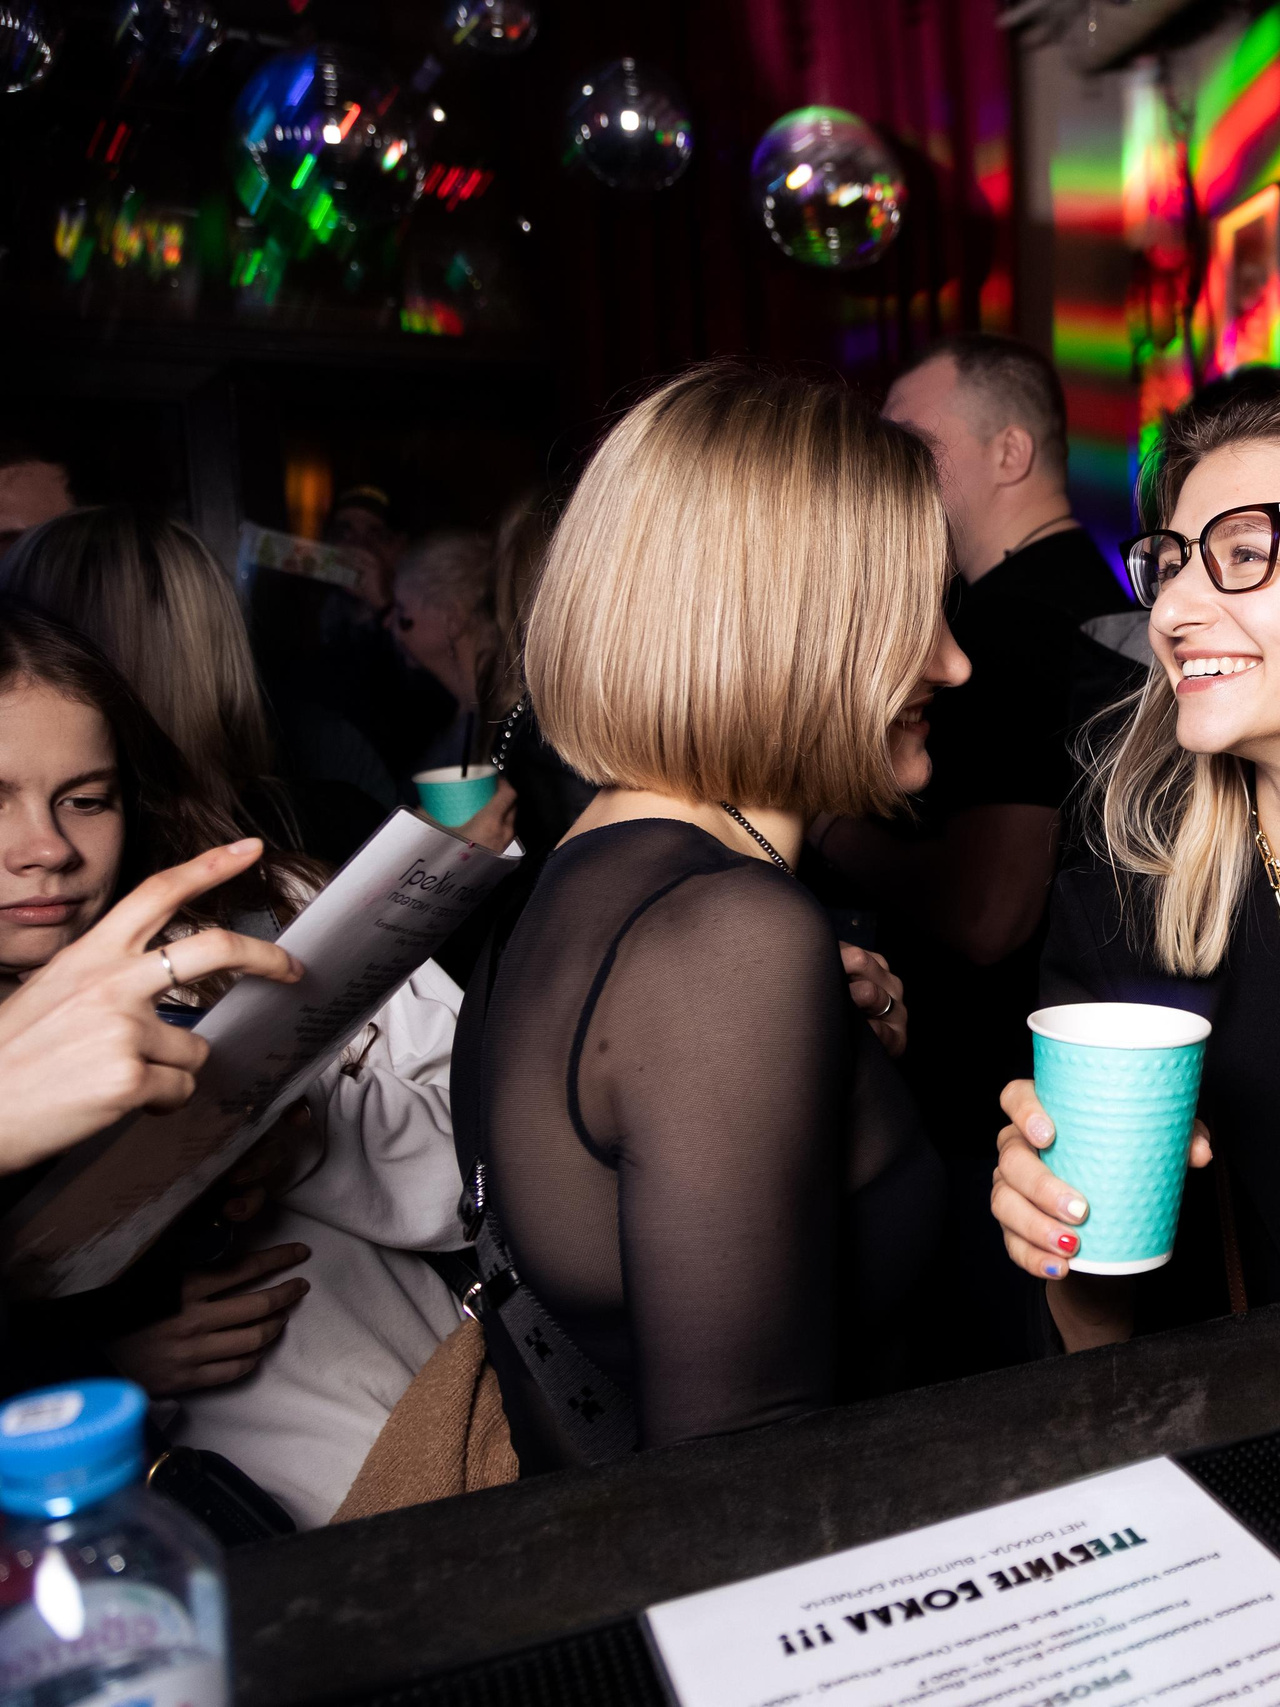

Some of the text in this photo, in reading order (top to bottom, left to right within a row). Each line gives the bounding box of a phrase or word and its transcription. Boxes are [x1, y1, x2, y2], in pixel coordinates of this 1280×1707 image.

[387, 891, 434, 915] поэтому
[1059, 1521, 1087, 1536] НЕТ
[989, 1531, 1055, 1556] БОКАЛА
[889, 1557, 976, 1587] ВЫПОРЕМ
[780, 1528, 1147, 1655] ТРЕБУЙТЕ БОКАЛ !!!
[801, 1583, 885, 1611] БАРМЕНА
